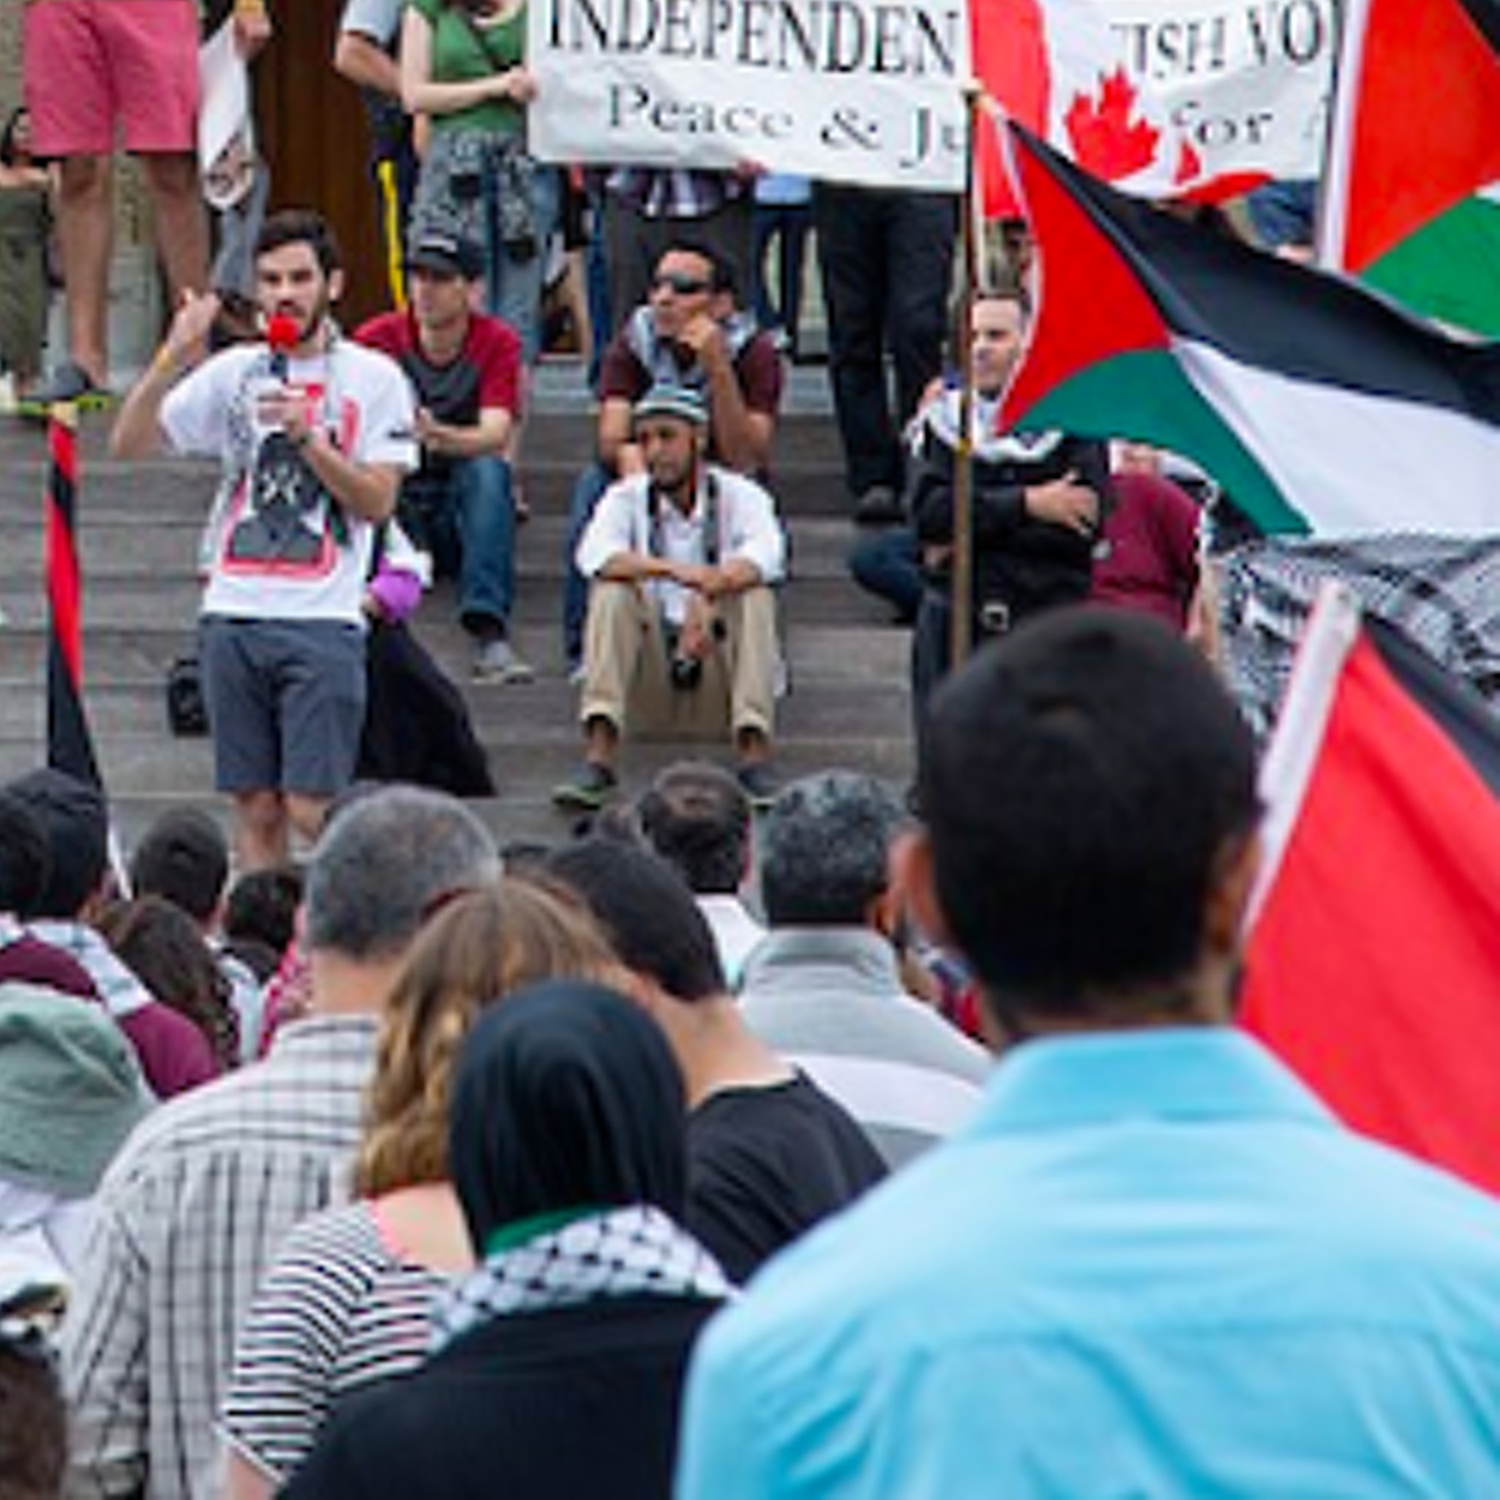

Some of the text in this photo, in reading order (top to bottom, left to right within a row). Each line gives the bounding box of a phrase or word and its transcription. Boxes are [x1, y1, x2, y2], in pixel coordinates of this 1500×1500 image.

[1109, 16, 1226, 80] ISH
[608, 82, 795, 141] Peace
[820, 106, 882, 152] &
